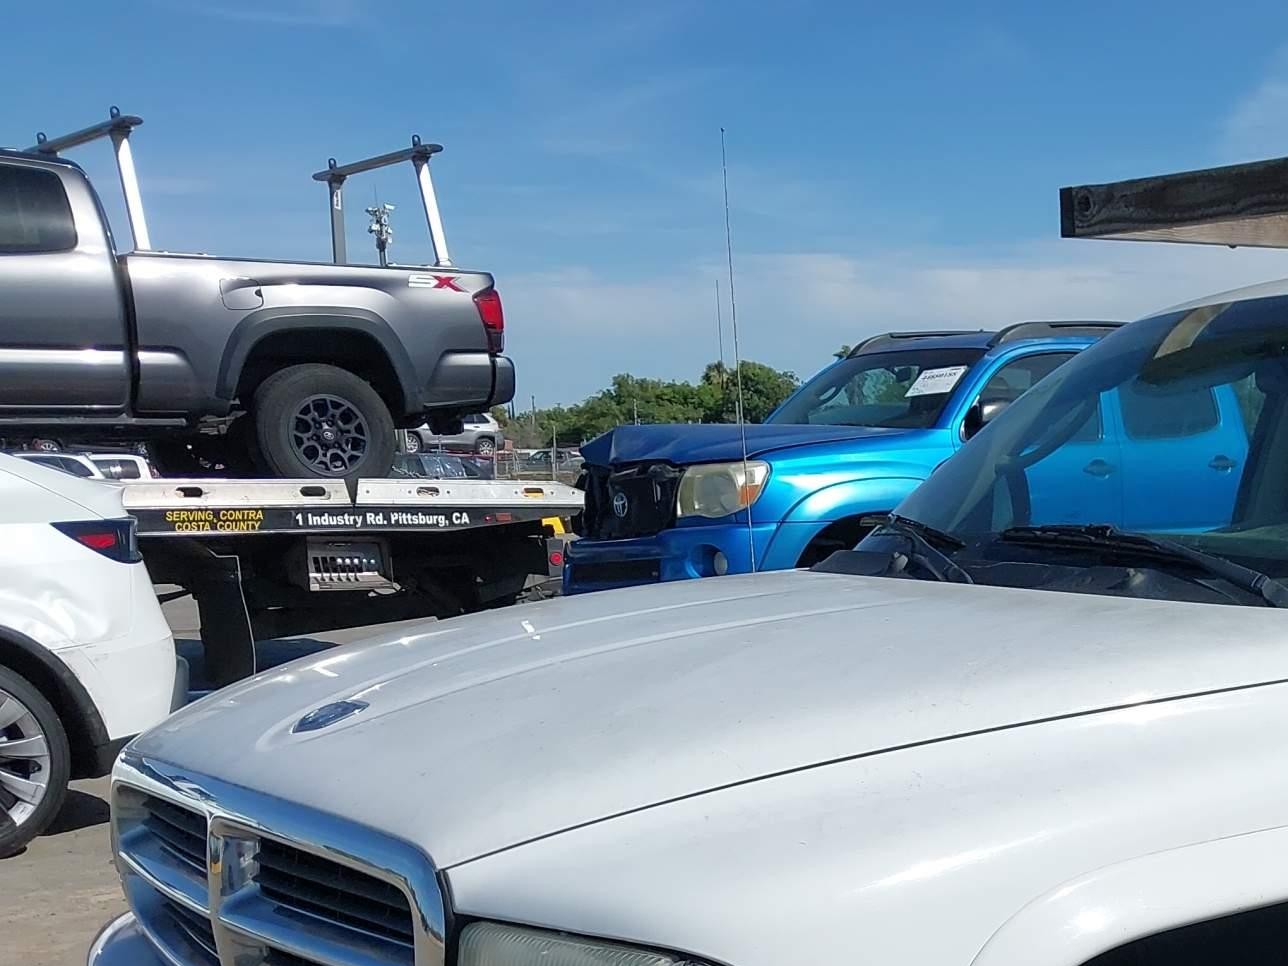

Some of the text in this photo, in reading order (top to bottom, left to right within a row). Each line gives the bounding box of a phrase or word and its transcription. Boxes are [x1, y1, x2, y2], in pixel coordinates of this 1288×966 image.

[408, 274, 468, 293] SX
[165, 510, 264, 521] SERVING CONTRA
[295, 512, 470, 528] 1 Industry Rd. Pittsburg, CA
[175, 521, 261, 532] COSTA COUNTY
